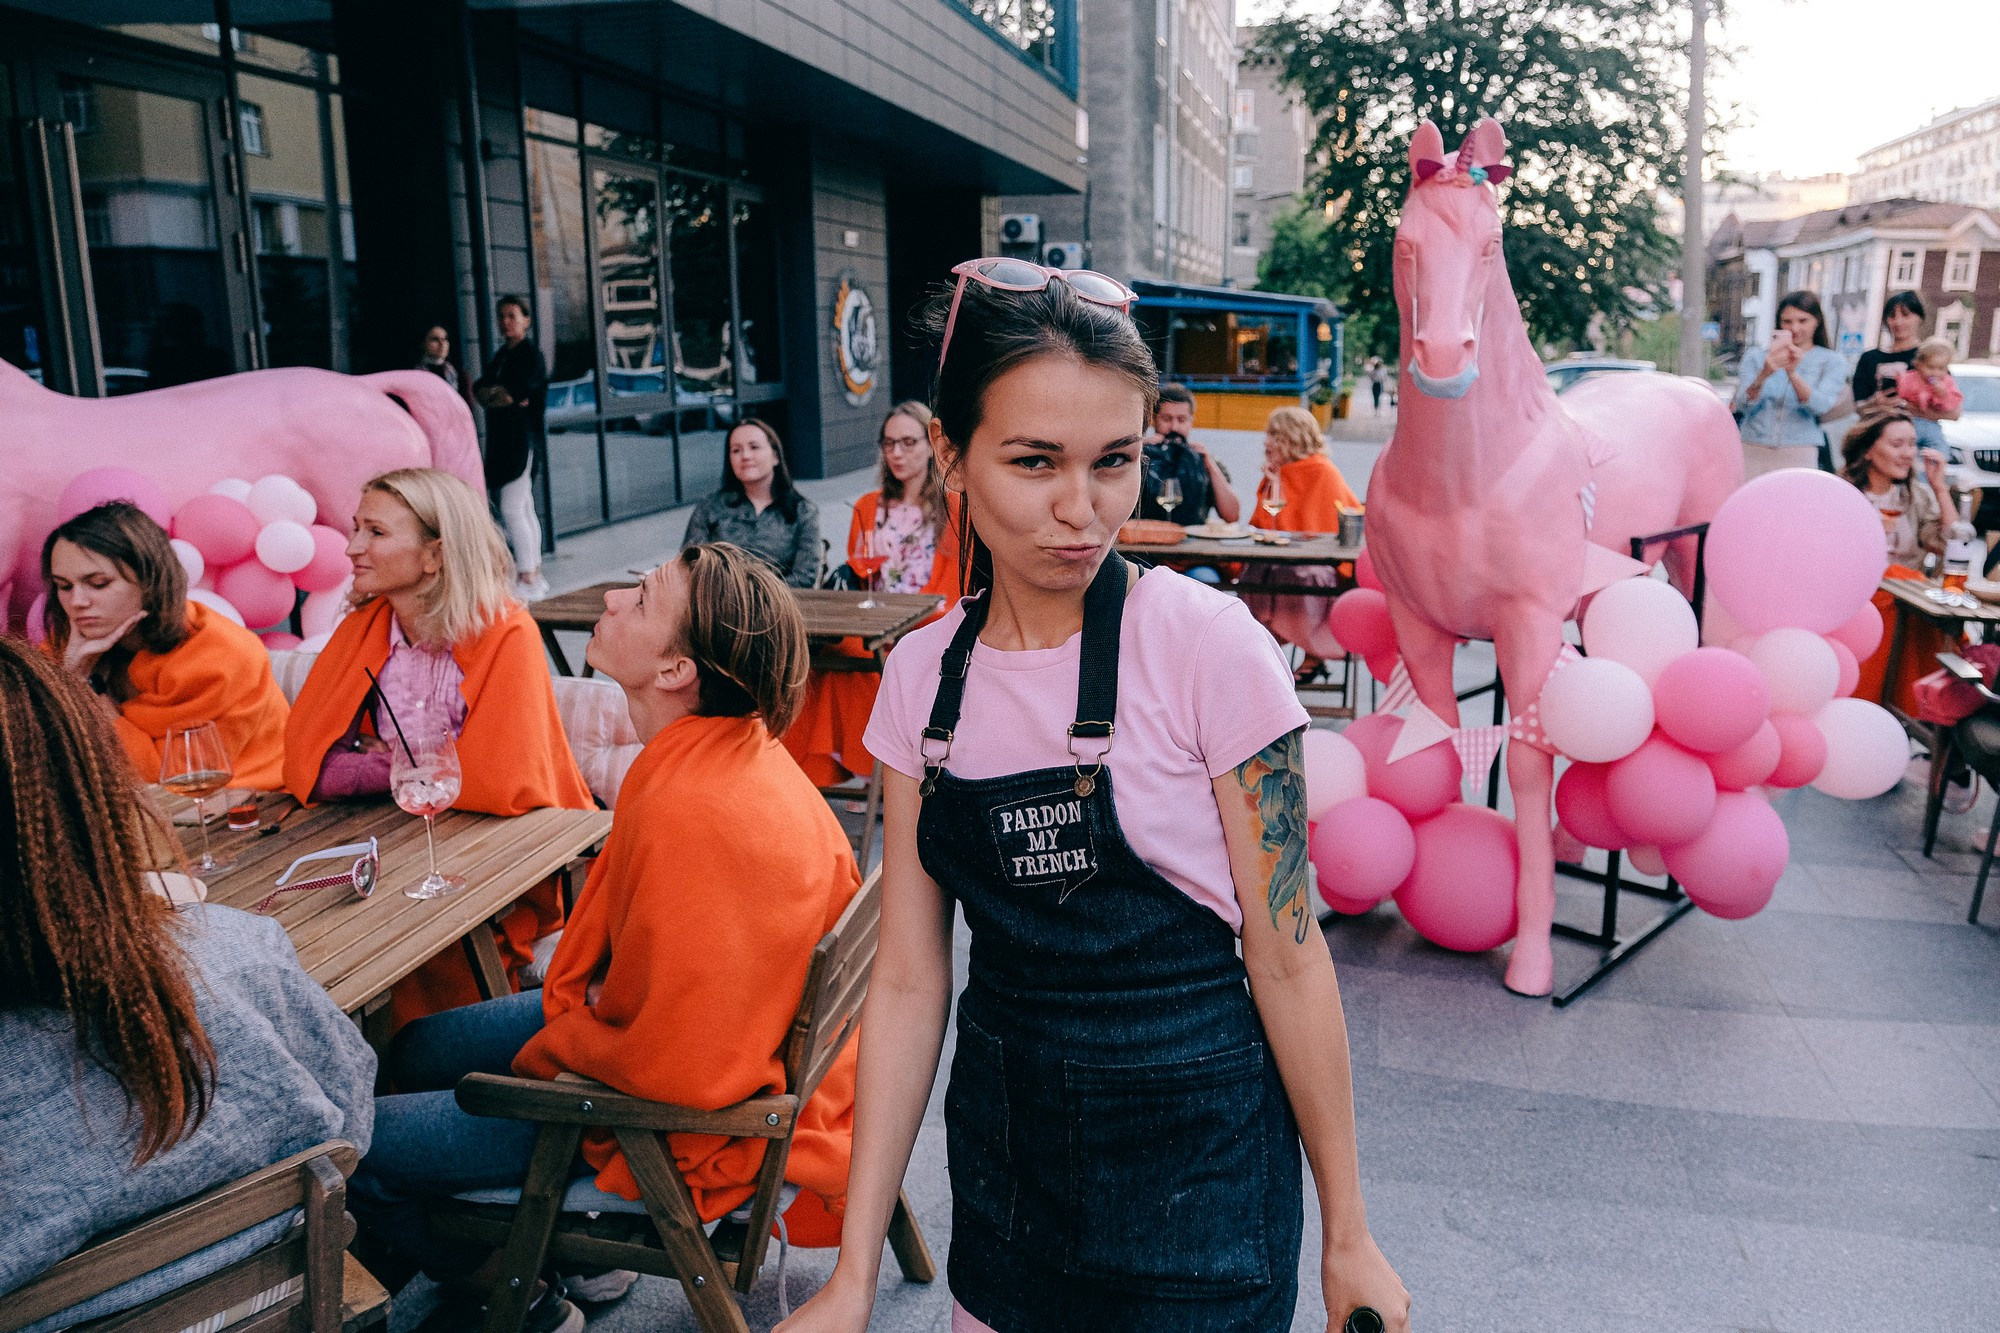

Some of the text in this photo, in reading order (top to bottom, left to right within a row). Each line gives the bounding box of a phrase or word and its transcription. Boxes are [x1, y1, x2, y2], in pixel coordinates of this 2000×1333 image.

[1000, 801, 1082, 833] PARDON
[1026, 828, 1060, 852] MY
[1012, 848, 1088, 877] FRENCH
